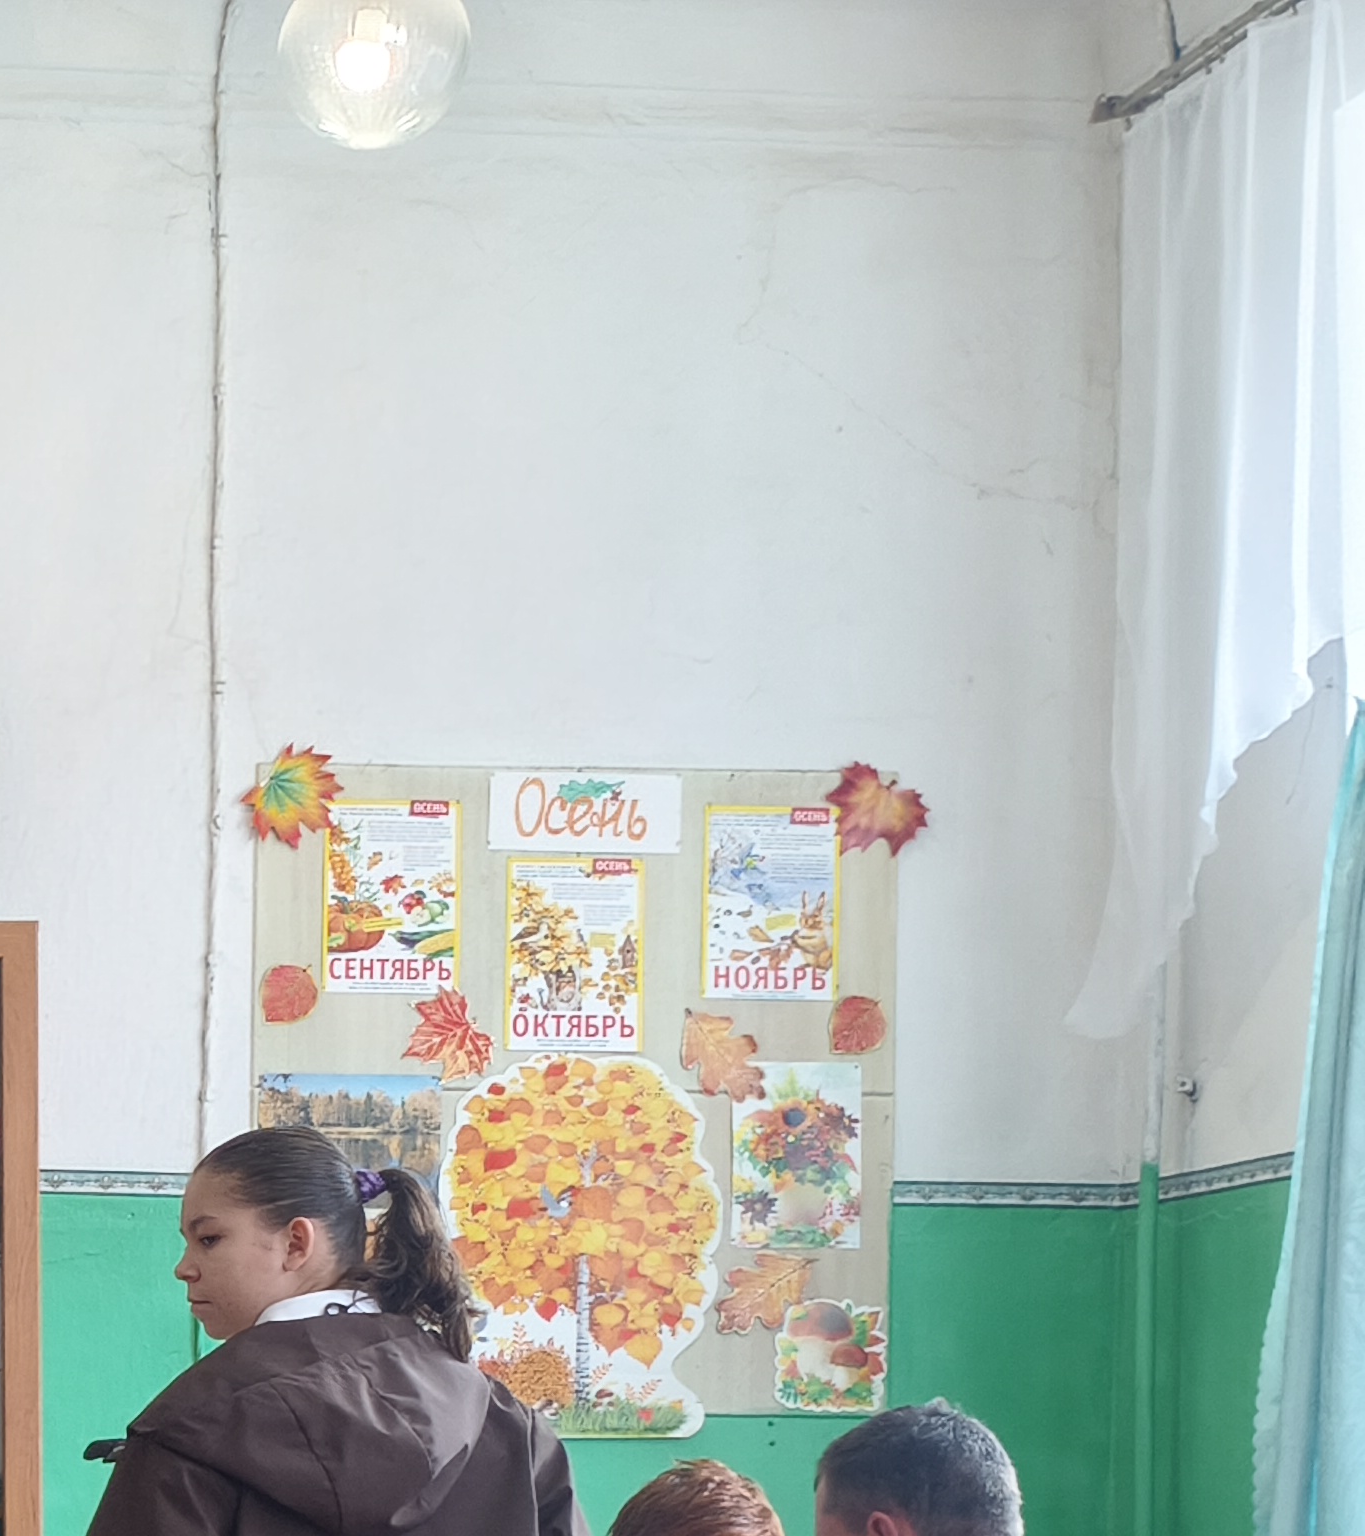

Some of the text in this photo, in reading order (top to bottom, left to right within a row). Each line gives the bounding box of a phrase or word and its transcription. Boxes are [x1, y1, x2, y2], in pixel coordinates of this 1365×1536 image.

[413, 801, 448, 814] ОСЕНЬ
[514, 777, 648, 841] Осень
[793, 810, 829, 823] ОСЕНЬ
[595, 860, 631, 872] ОСЕНЬ
[328, 957, 452, 981] СЕНТЯБРЬ
[713, 965, 827, 991] НОЯБРЬ
[512, 1013, 635, 1038] ОКТЯБРЬ
